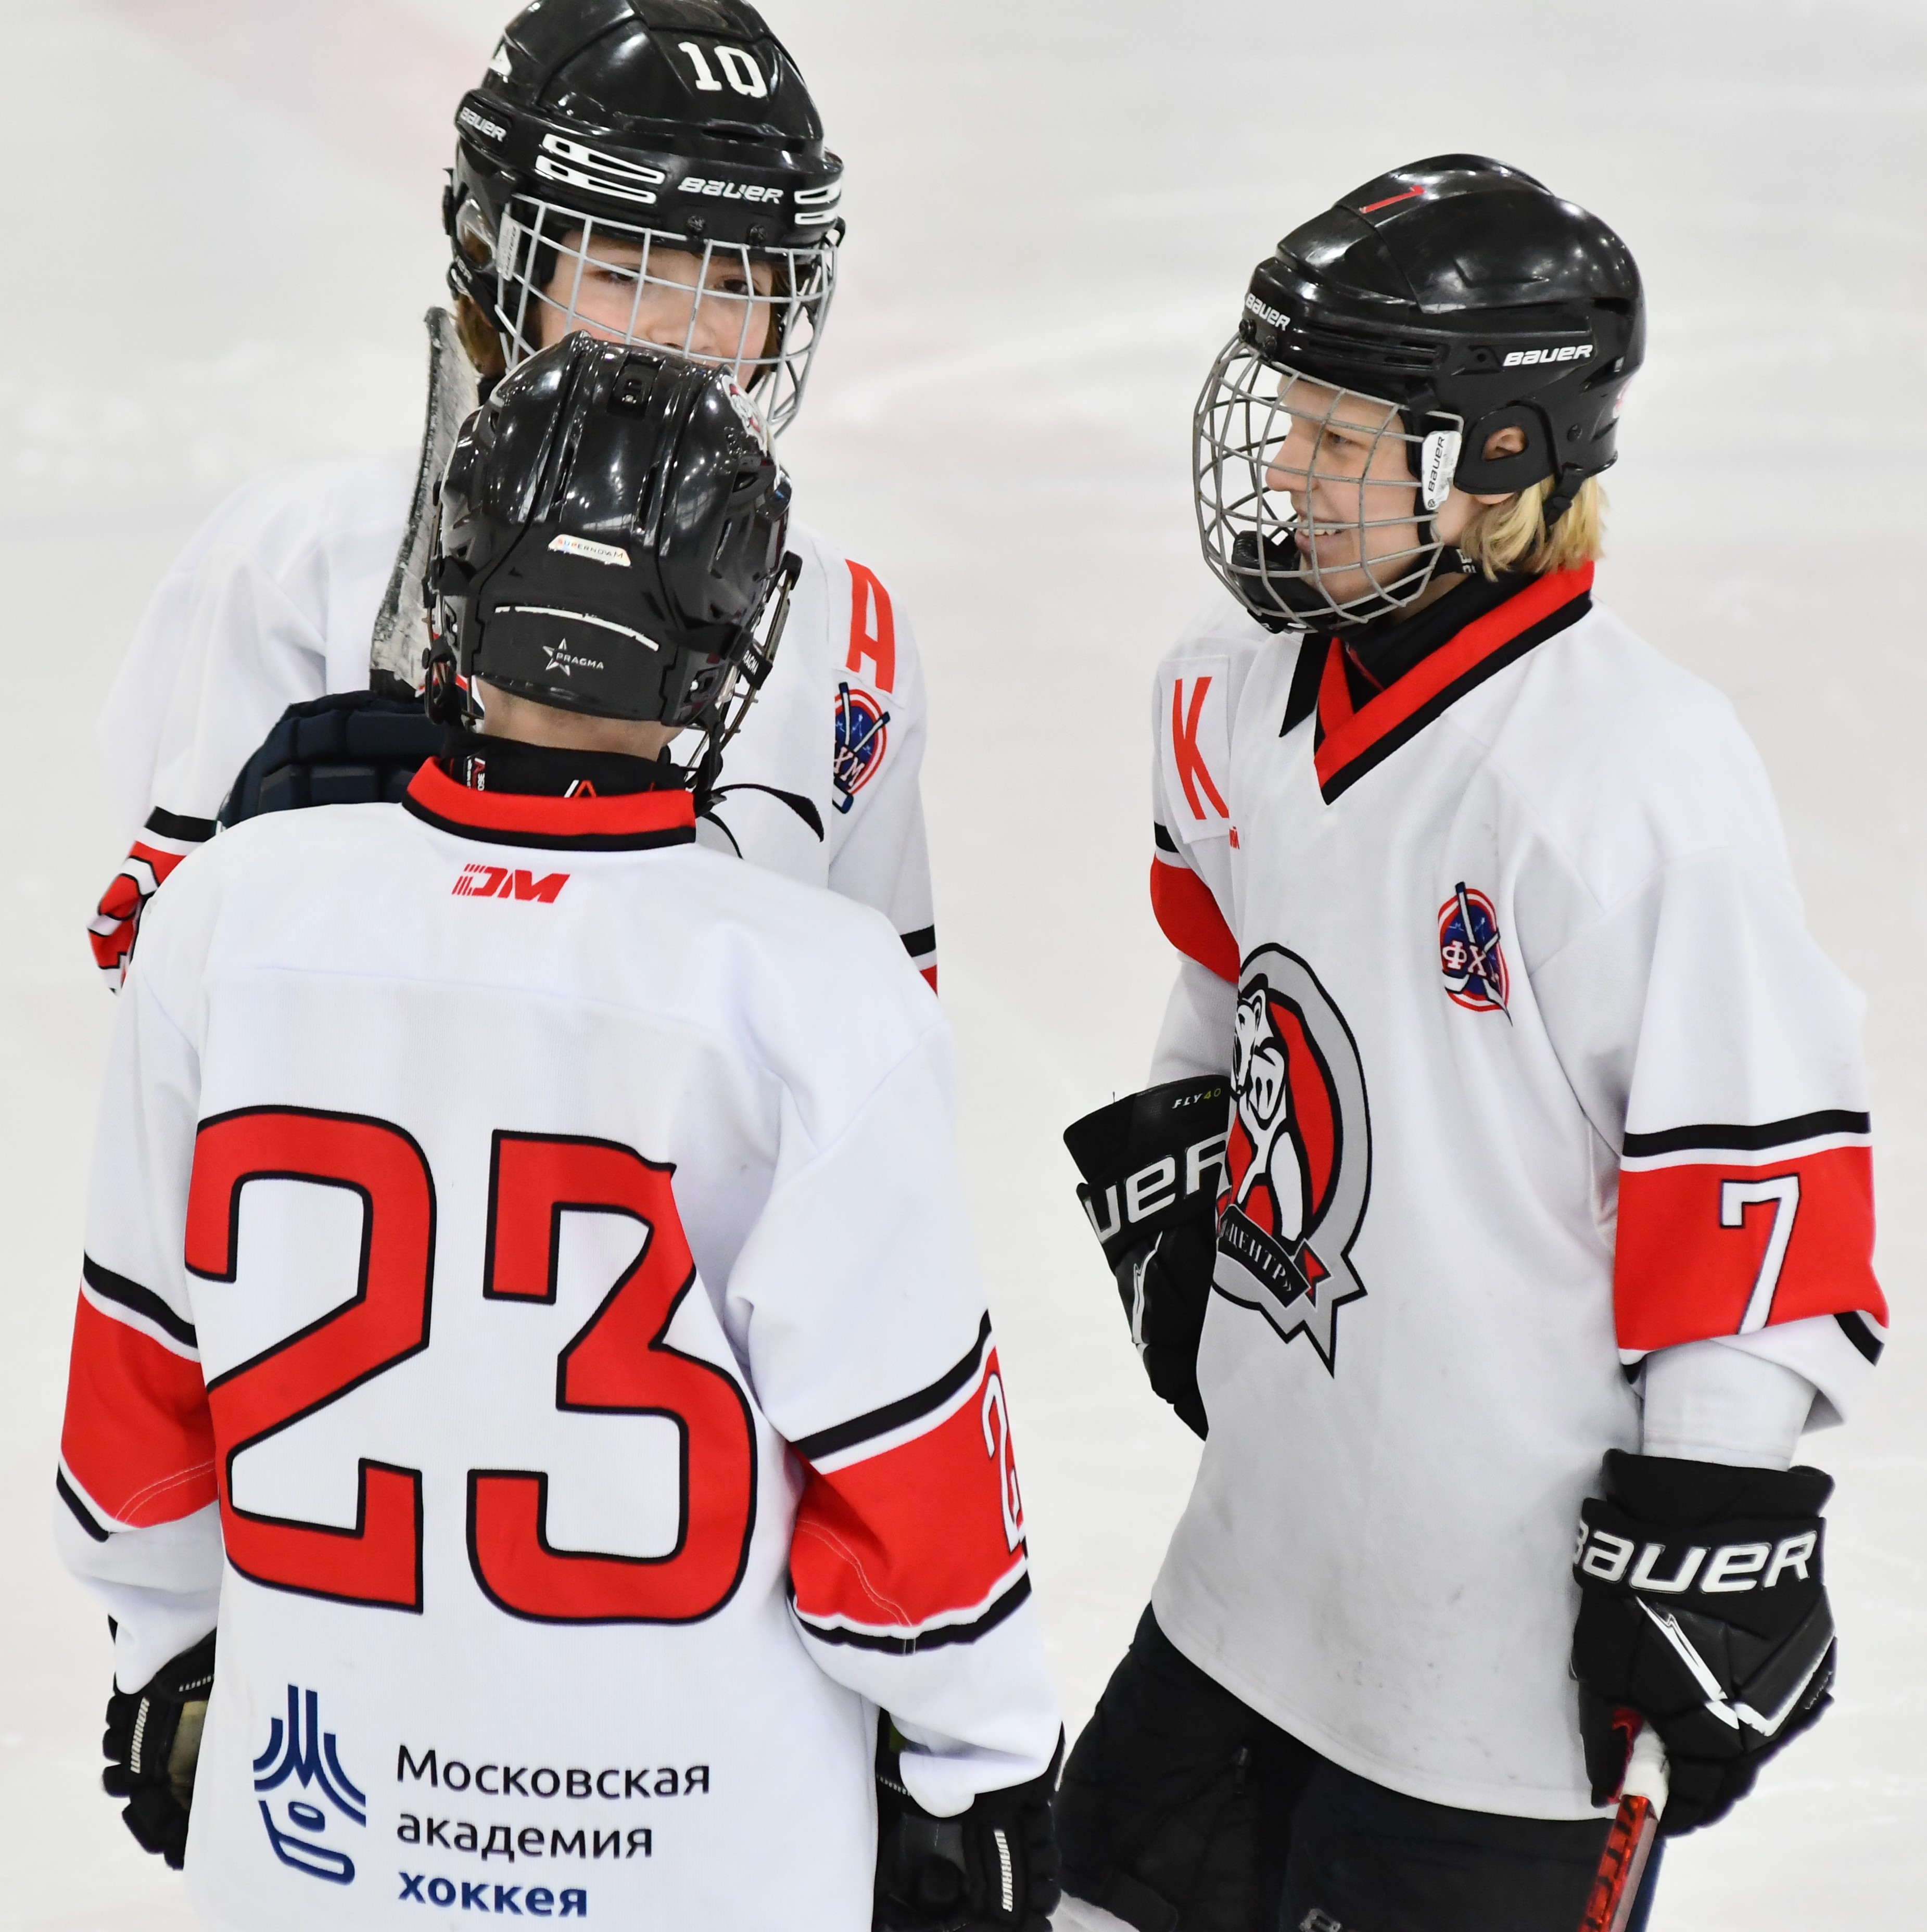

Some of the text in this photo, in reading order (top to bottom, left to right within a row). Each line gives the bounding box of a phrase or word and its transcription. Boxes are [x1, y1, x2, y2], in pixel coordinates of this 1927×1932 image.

[678, 41, 768, 98] 10
[460, 106, 507, 143] BAUER
[678, 176, 784, 204] BAUER
[1246, 293, 1291, 331] BAUER
[1503, 344, 1593, 366] BAUER
[1428, 436, 1446, 492] BAUER
[556, 652, 604, 670] PRAGMA
[742, 649, 759, 676] RAGMA
[834, 746, 866, 787] ХМ
[1085, 1130, 1229, 1244] UER
[1719, 1172, 1801, 1336] 7
[184, 1104, 757, 1626] 23
[397, 1744, 709, 1800] Московская
[397, 1812, 653, 1863] академия
[398, 1871, 587, 1918] хоккея
[993, 1828, 1013, 1912] WARRIOR
